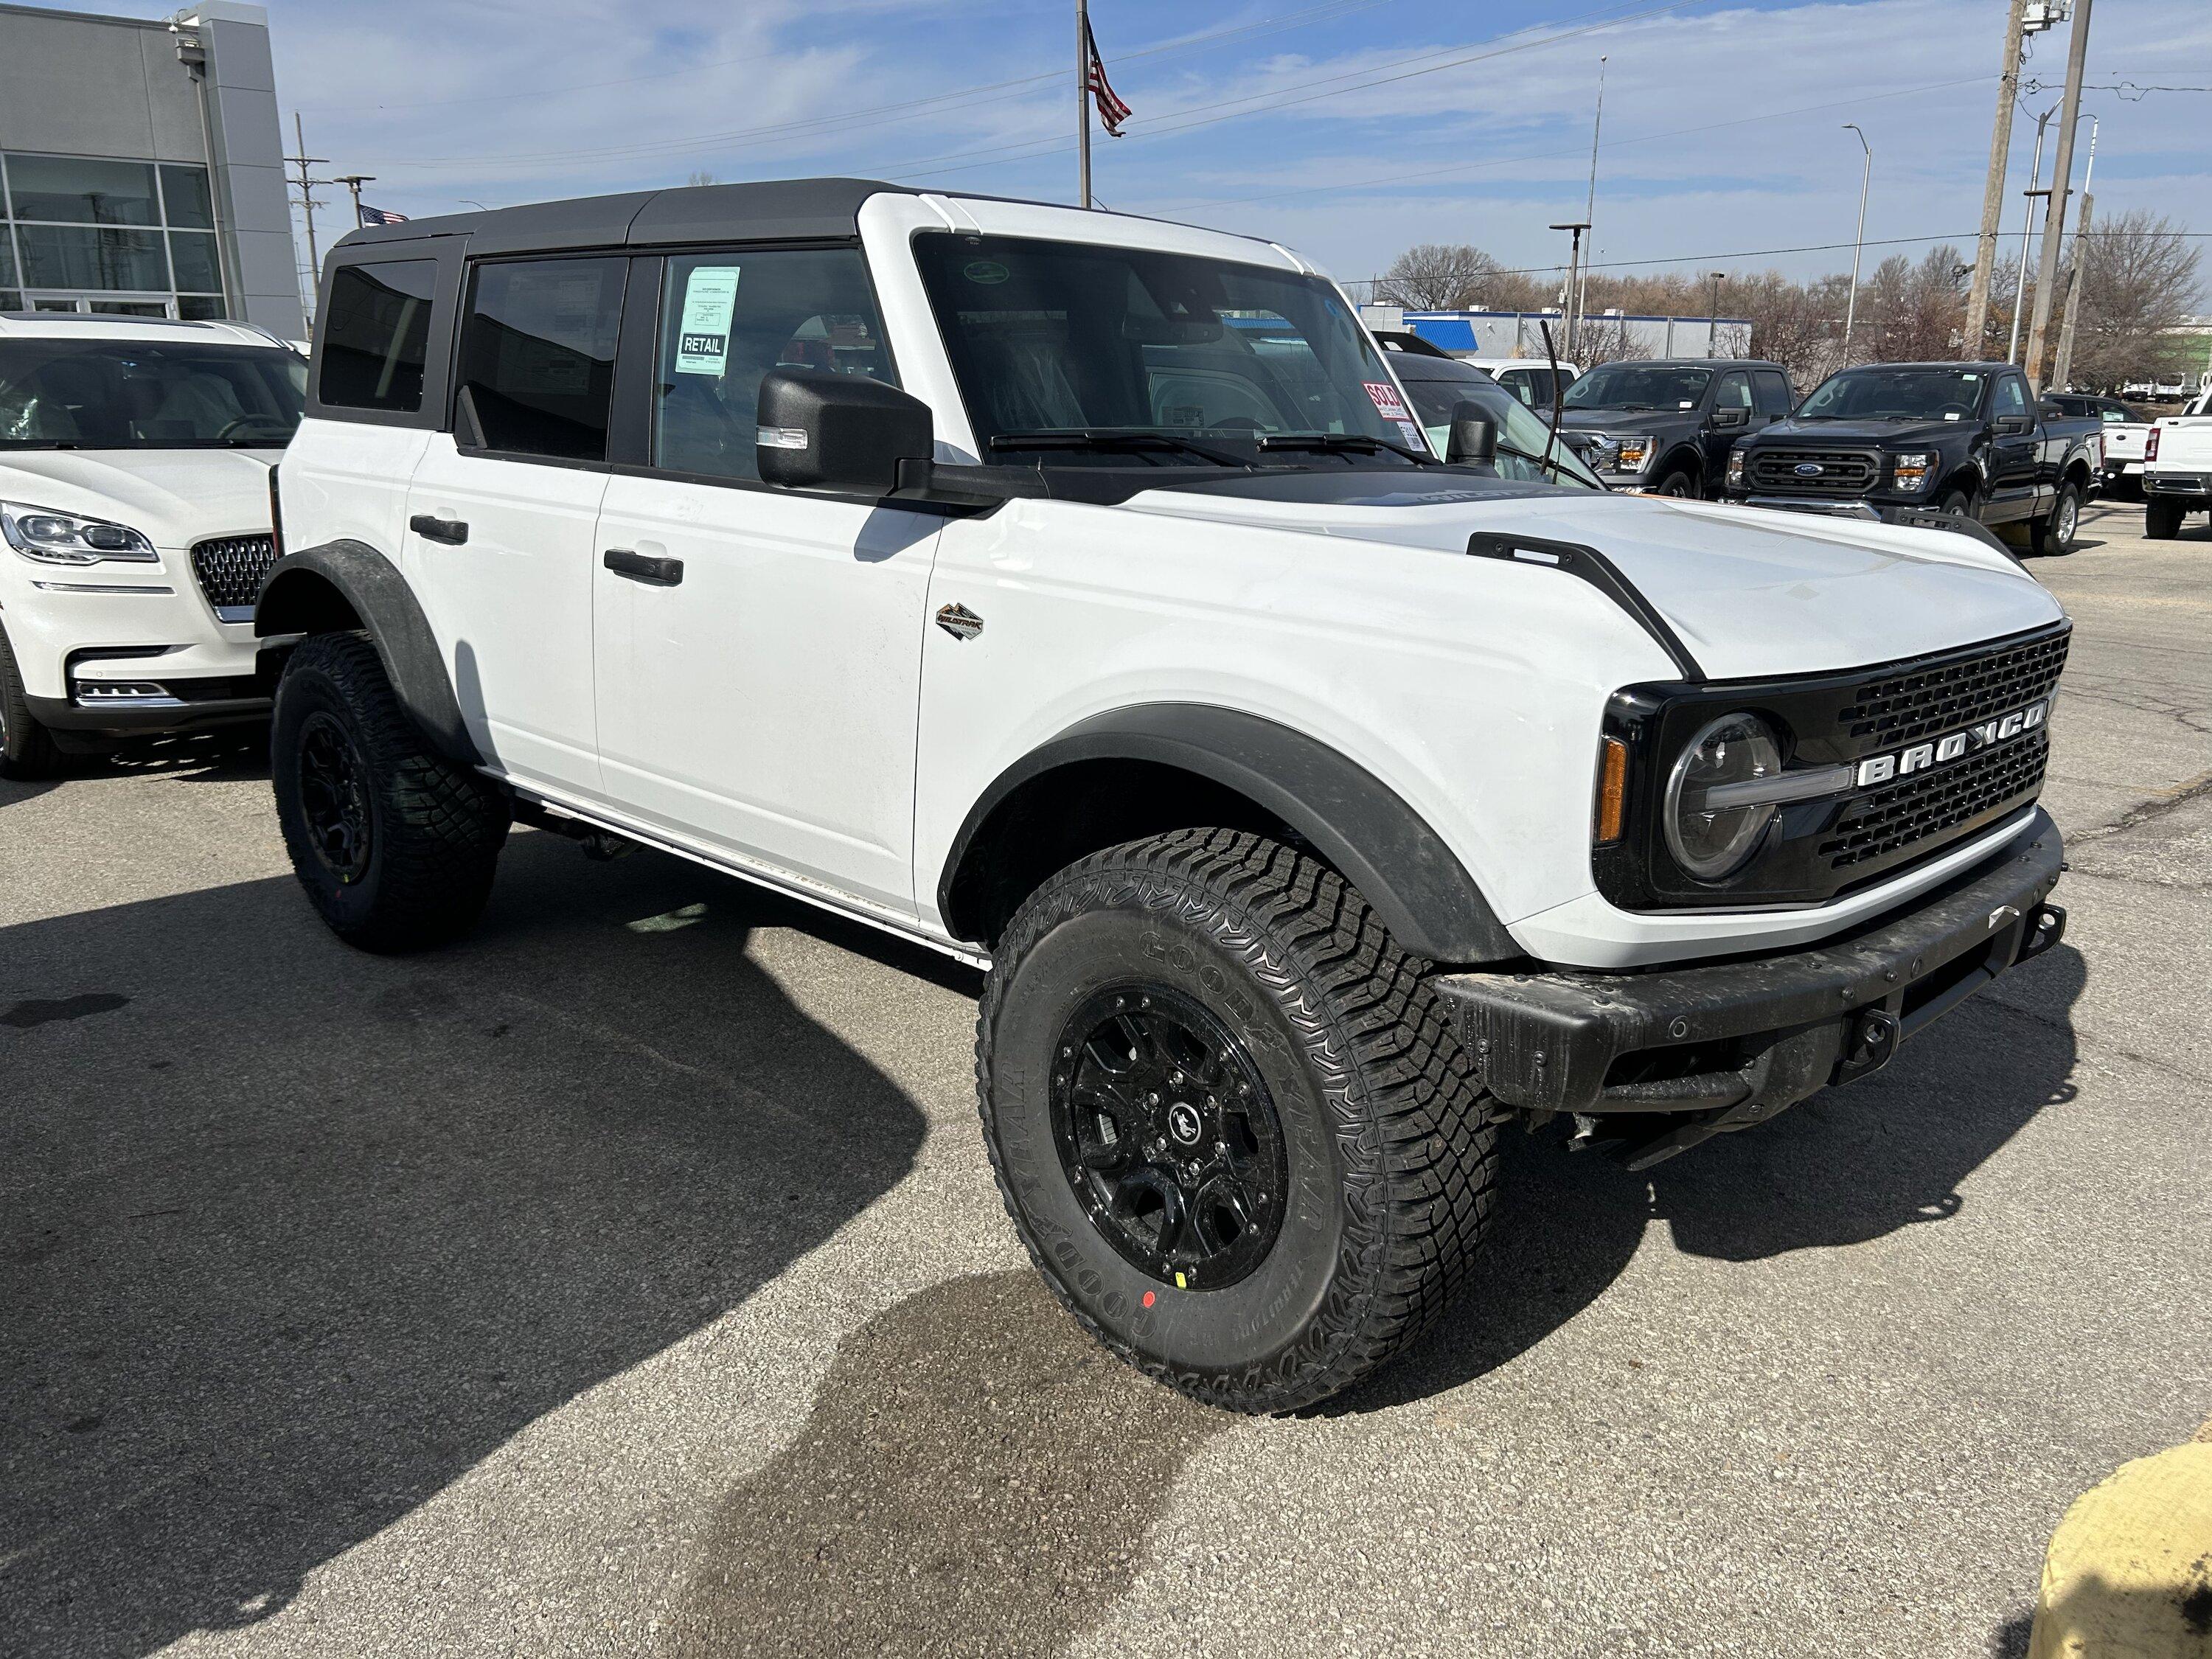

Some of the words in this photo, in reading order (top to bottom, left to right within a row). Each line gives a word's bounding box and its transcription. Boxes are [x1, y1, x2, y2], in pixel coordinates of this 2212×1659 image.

[684, 336, 721, 353] RETAIL
[1366, 385, 1401, 406] SOLD
[1857, 703, 2044, 787] BRONCO
